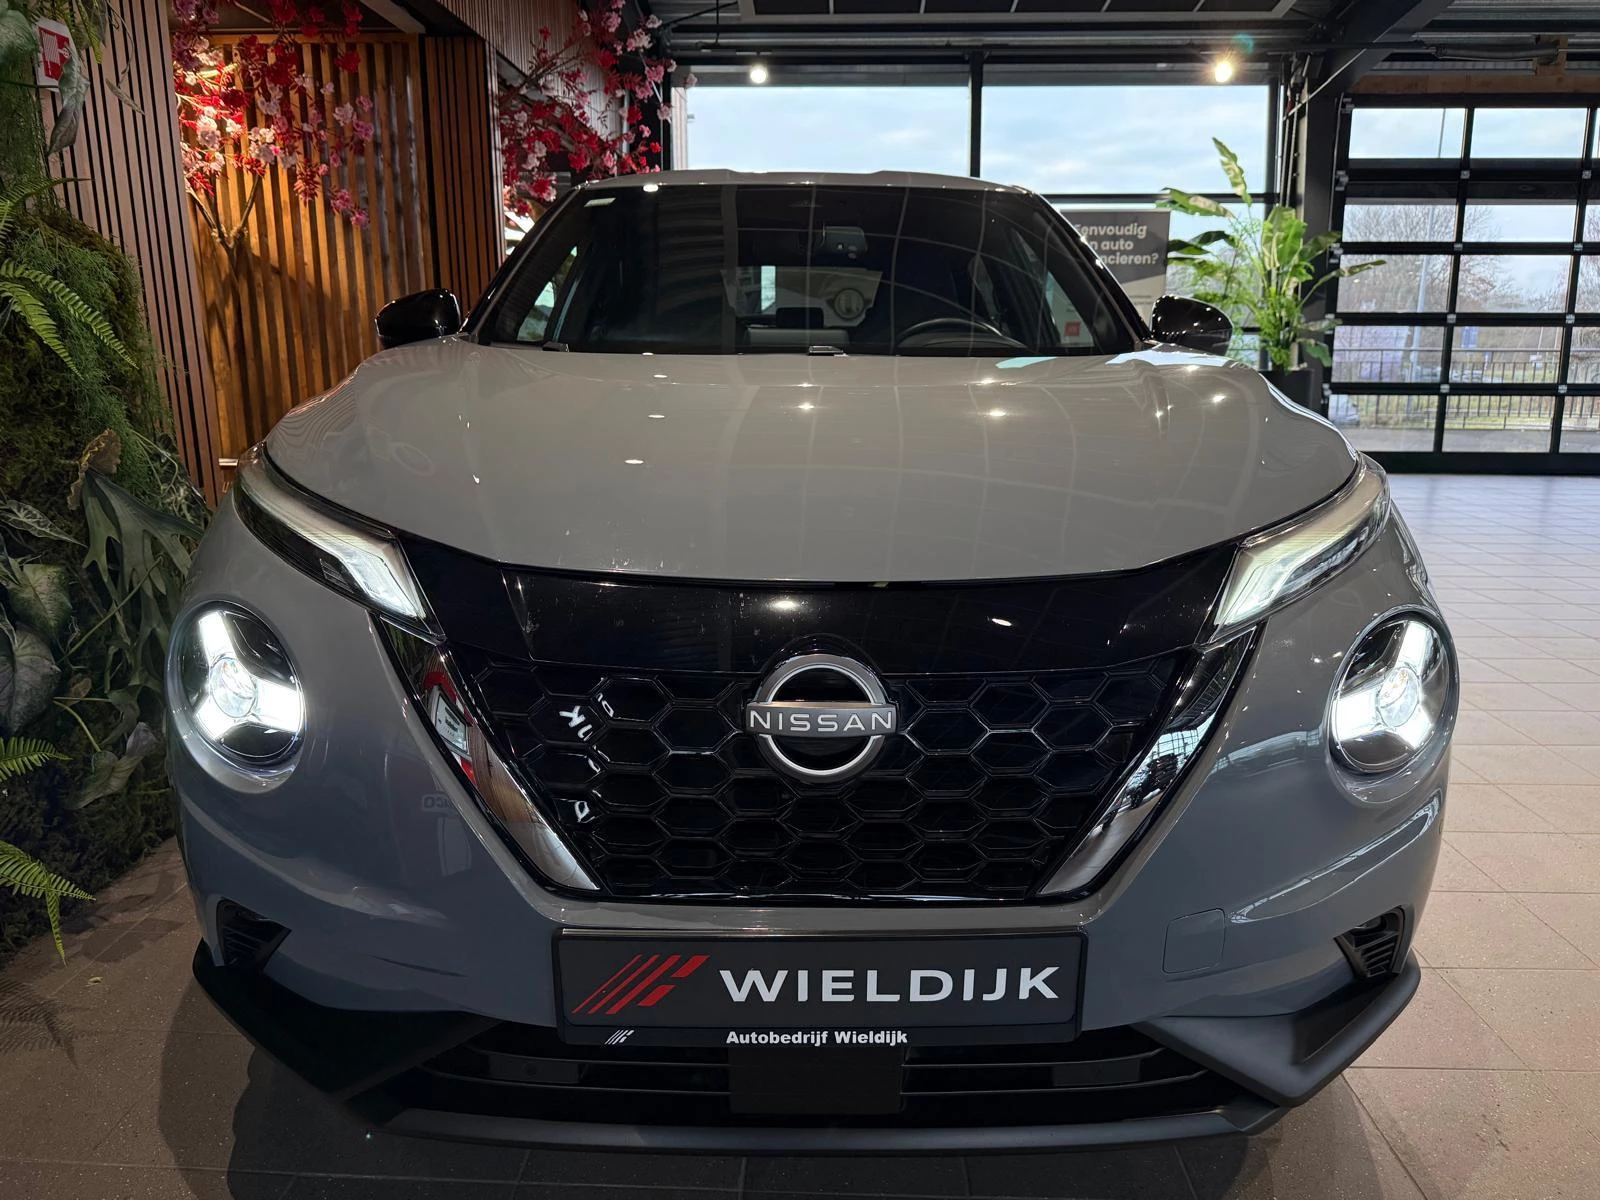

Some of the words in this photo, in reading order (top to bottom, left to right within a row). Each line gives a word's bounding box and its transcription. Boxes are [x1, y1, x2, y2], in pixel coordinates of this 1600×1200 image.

[1101, 238, 1134, 250] auto
[1100, 252, 1159, 264] ncieren?
[750, 710, 893, 732] NISSAN
[719, 966, 1060, 1002] WIELDIJK
[726, 1031, 828, 1047] Autobedrijf
[834, 1030, 908, 1046] Wieldijk
